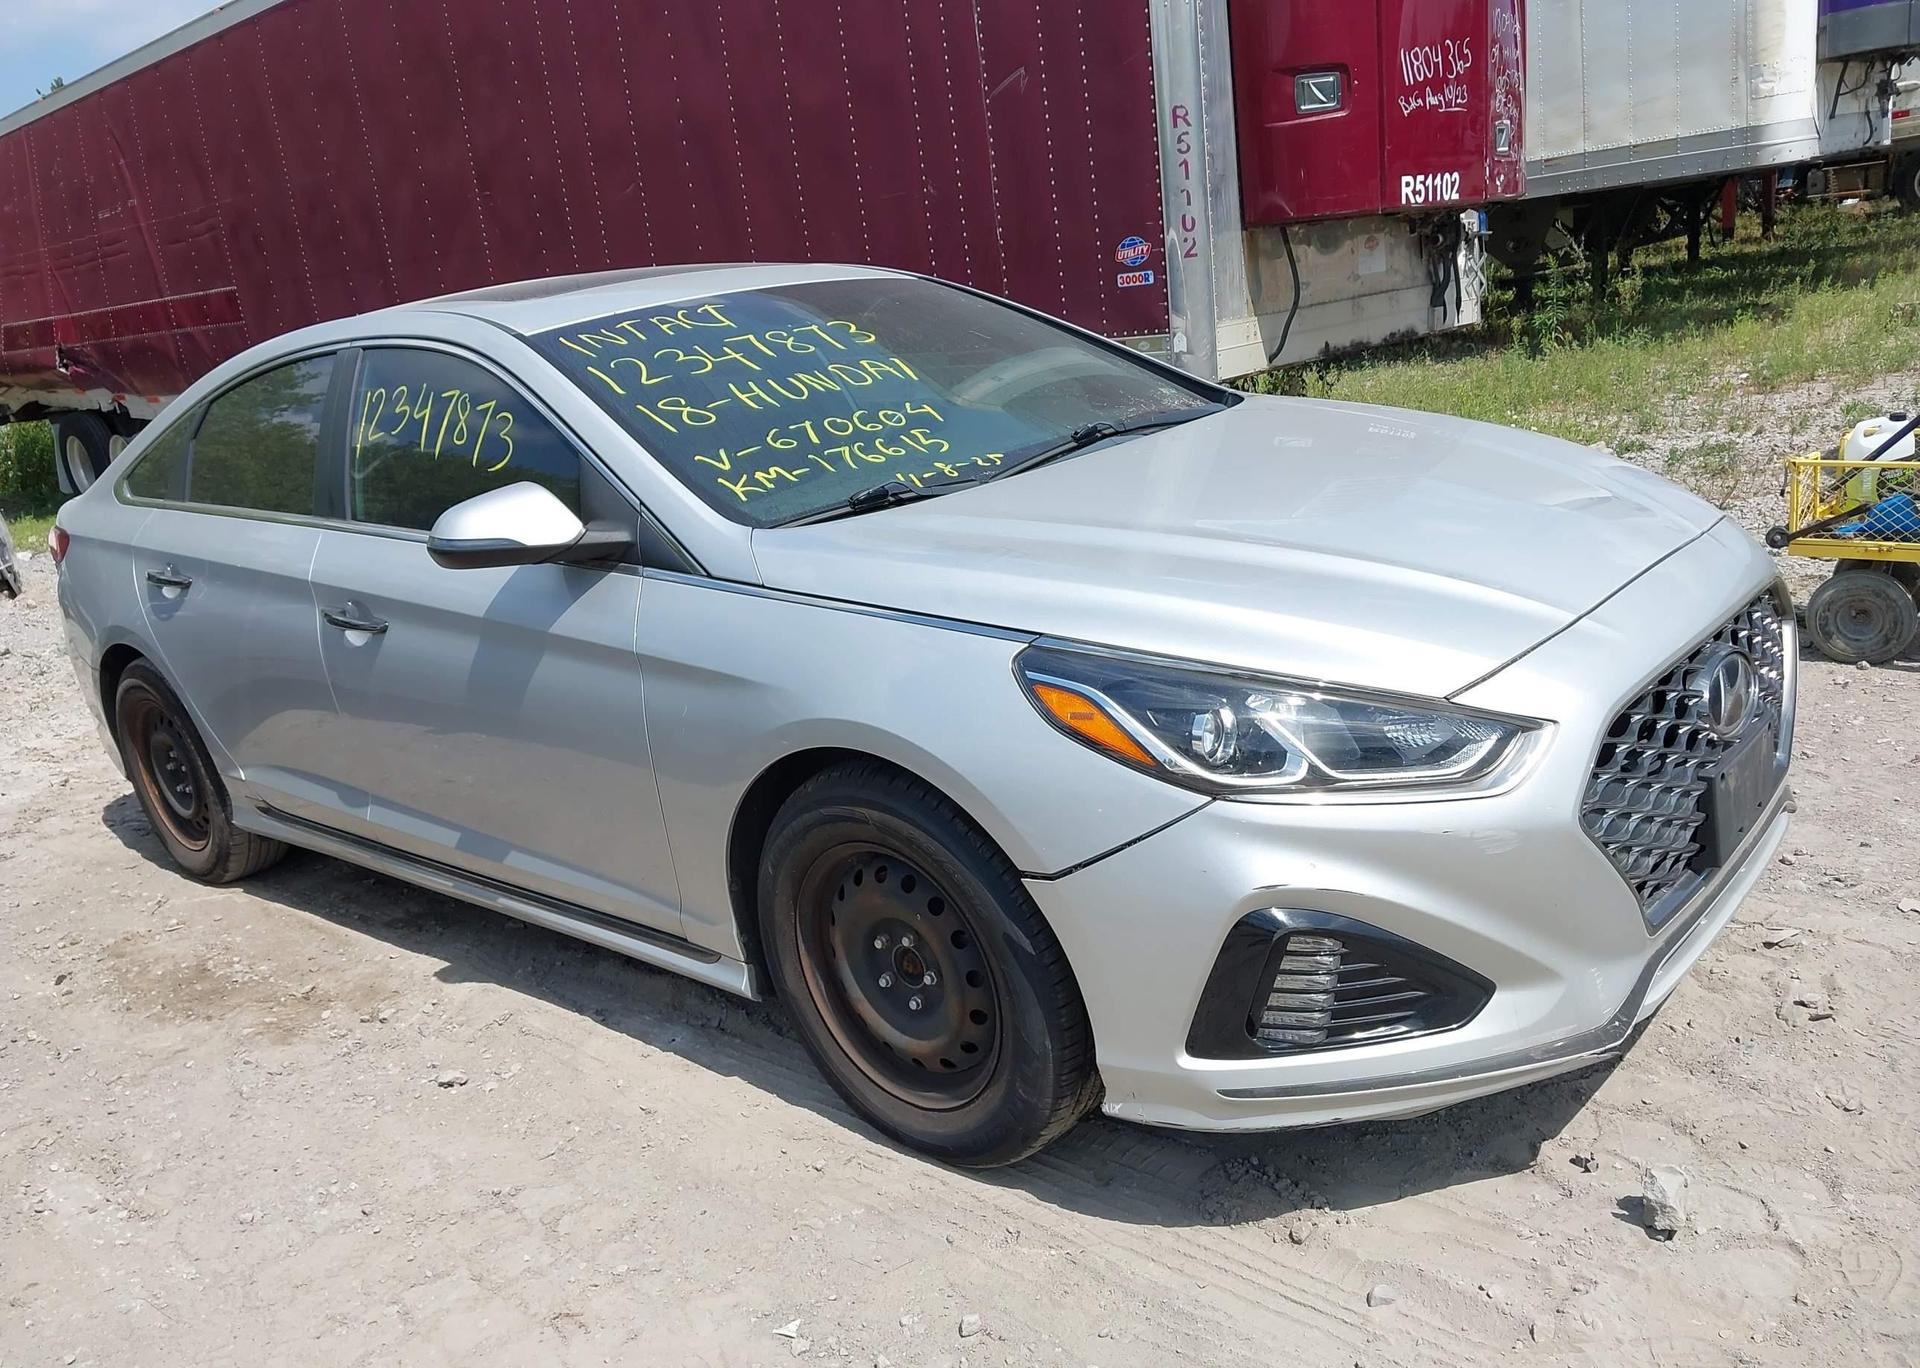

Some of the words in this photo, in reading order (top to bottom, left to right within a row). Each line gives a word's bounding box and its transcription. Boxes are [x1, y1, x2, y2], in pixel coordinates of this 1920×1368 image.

[1401, 171, 1460, 205] R51102
[1117, 244, 1150, 261] UTILITY
[1119, 272, 1151, 286] 3000R
[559, 304, 738, 357] INTACT
[587, 320, 876, 394] 12347873
[356, 383, 514, 472] 12347873
[694, 402, 944, 470] V-670604
[717, 428, 949, 502] KM-176615
